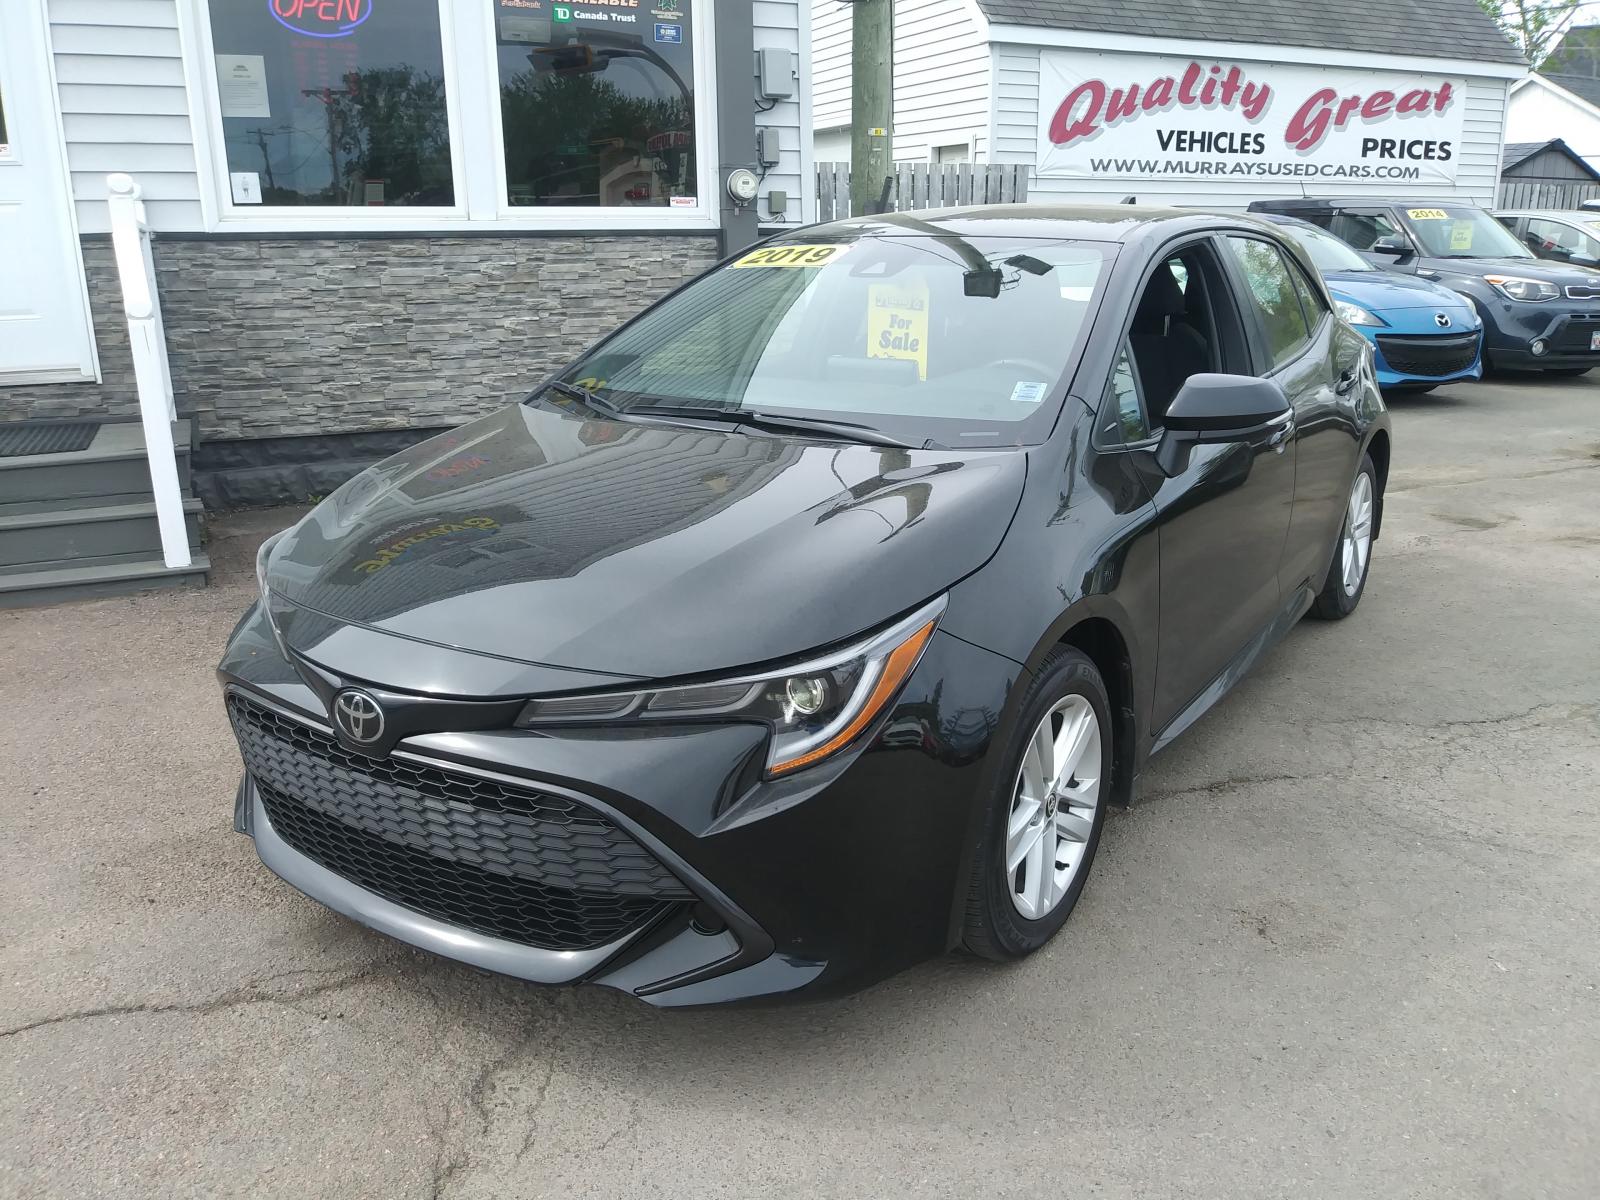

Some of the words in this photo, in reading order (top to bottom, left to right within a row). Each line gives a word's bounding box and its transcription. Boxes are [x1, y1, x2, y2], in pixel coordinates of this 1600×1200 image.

[274, 0, 360, 21] OPEN
[555, 8, 570, 19] TD
[573, 11, 608, 21] Canada
[610, 13, 637, 23] Trust
[1049, 61, 1273, 146] Quality
[1284, 82, 1453, 154] Great
[1157, 129, 1266, 155] VEHICLES
[1361, 138, 1452, 161] PRICES
[1090, 158, 1420, 180] WWW.MURRAYSUSEDCARS.COM
[1411, 210, 1444, 219] 2014
[741, 247, 838, 265] 2019
[889, 313, 912, 330] For
[879, 330, 920, 353] Sale
